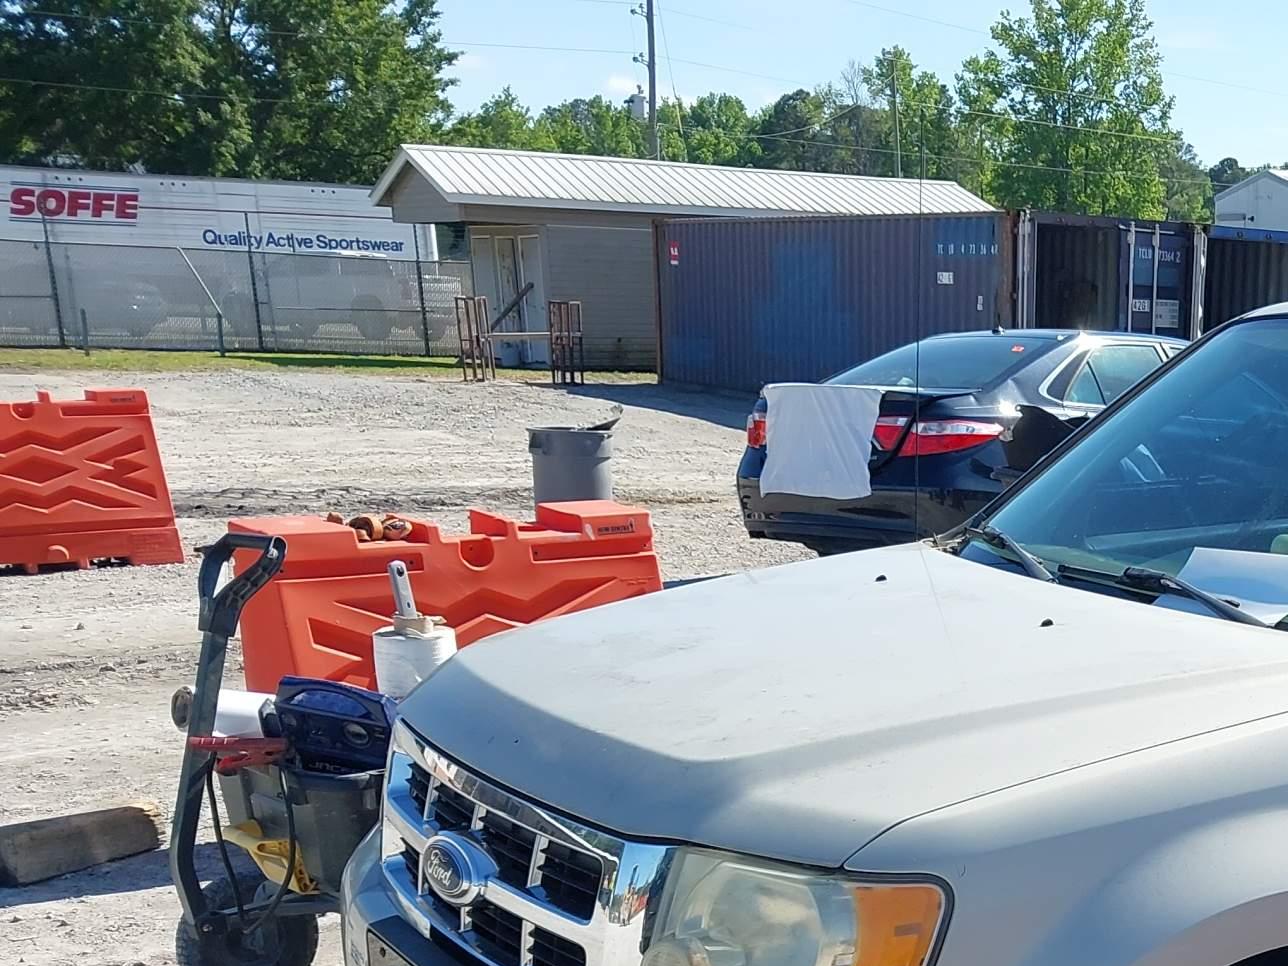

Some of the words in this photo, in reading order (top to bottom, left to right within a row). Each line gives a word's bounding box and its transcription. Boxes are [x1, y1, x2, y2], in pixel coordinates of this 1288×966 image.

[10, 188, 138, 219] SOFFE
[203, 229, 263, 249] Quality
[265, 232, 313, 249] Actve
[316, 235, 404, 252] Sportswear
[427, 849, 454, 888] Ford
